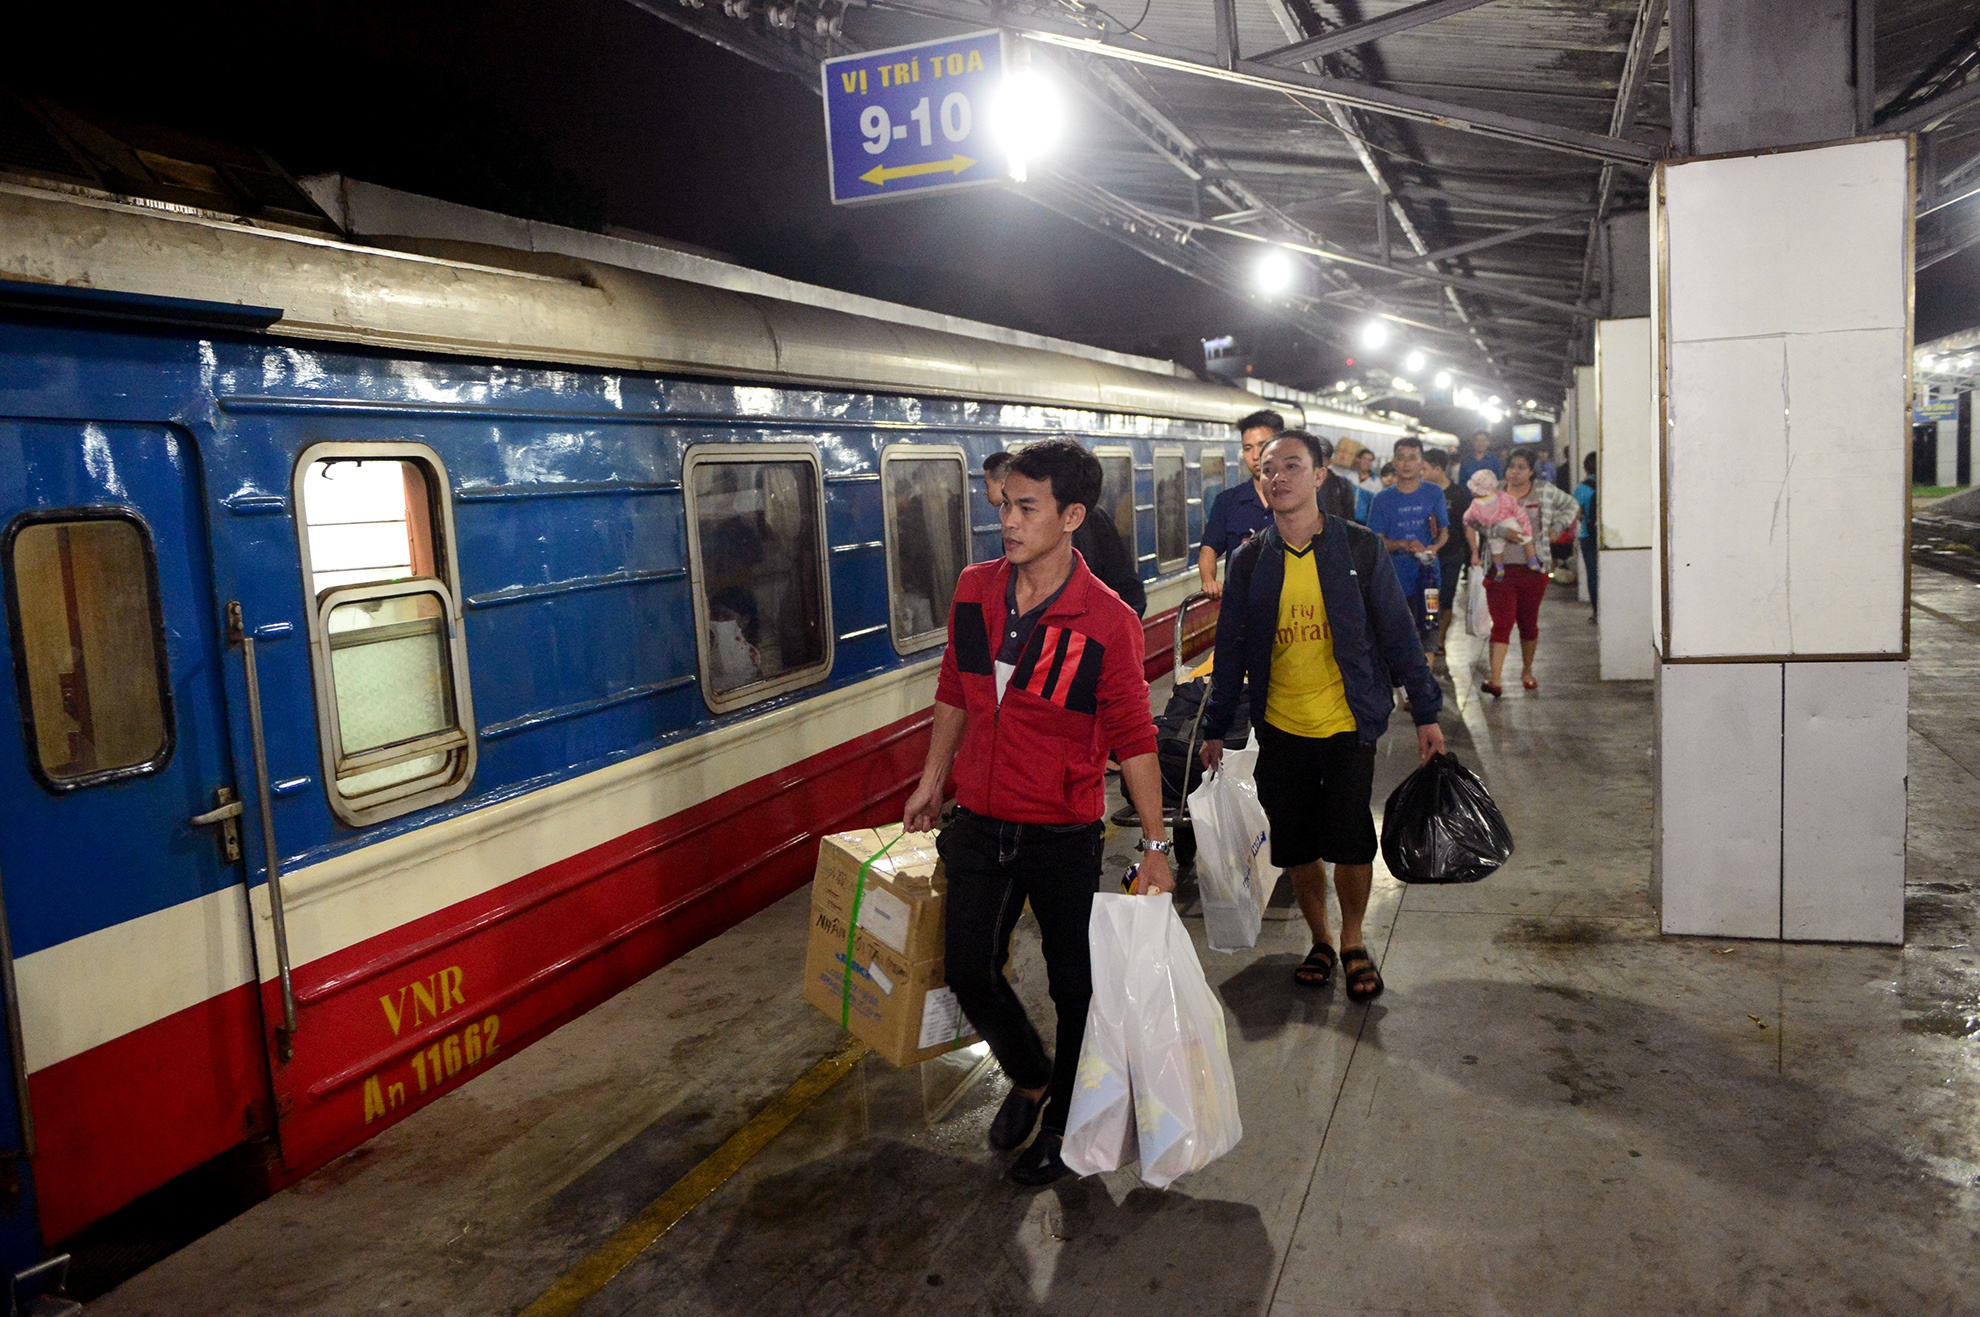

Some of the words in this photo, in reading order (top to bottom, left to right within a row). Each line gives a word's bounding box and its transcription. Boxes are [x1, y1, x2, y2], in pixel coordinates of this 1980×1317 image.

[841, 69, 868, 95] VỊ
[877, 56, 920, 88] TRÍ
[930, 50, 985, 78] TOA
[859, 92, 972, 155] 9-10
[1291, 604, 1315, 620] Fly
[378, 965, 466, 1036] VNR
[365, 1073, 405, 1125] An
[411, 1014, 500, 1092] 11662
